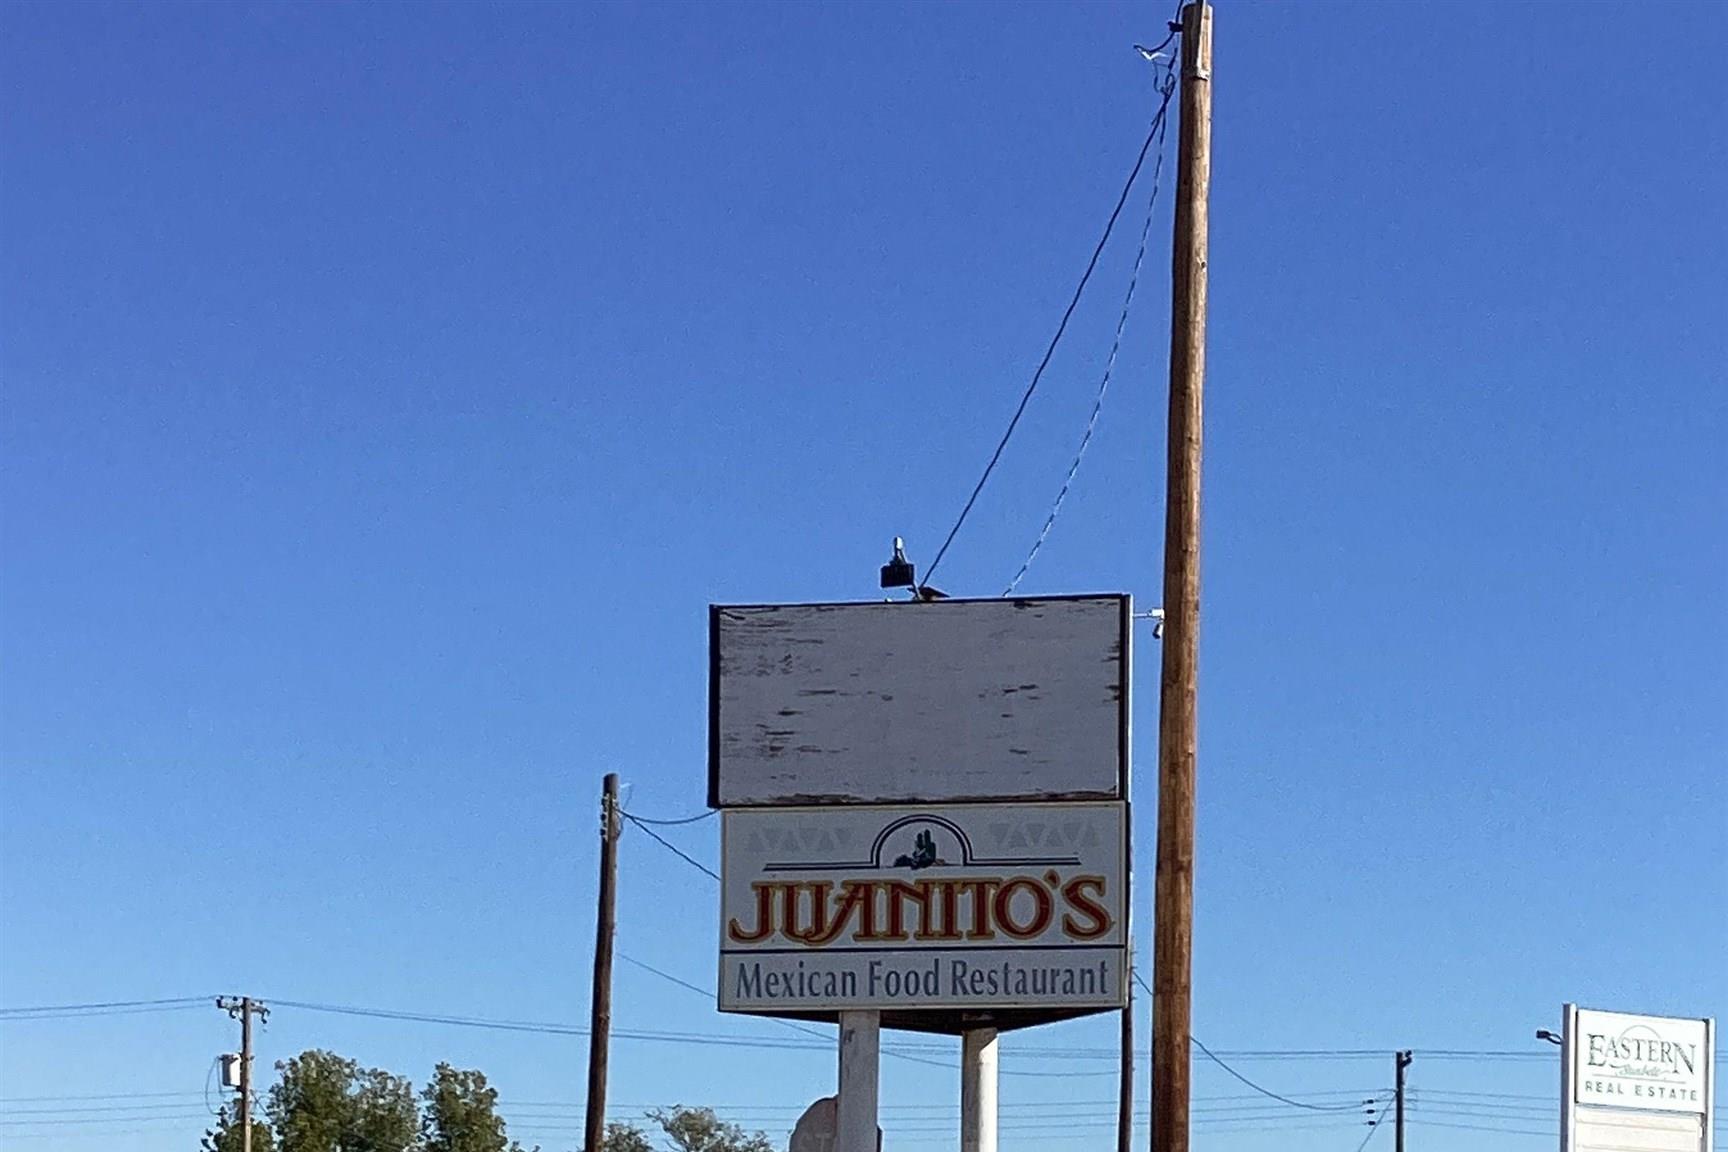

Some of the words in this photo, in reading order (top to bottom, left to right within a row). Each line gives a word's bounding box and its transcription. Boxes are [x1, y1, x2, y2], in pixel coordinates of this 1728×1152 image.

[728, 869, 1113, 946] JUANITO'S
[736, 961, 857, 998] Mexican
[868, 958, 940, 997] Food
[951, 958, 1109, 995] Restaurant
[1586, 1033, 1697, 1076] EASTERN
[1585, 1081, 1624, 1095] REAL
[1635, 1084, 1698, 1101] ESTATE
